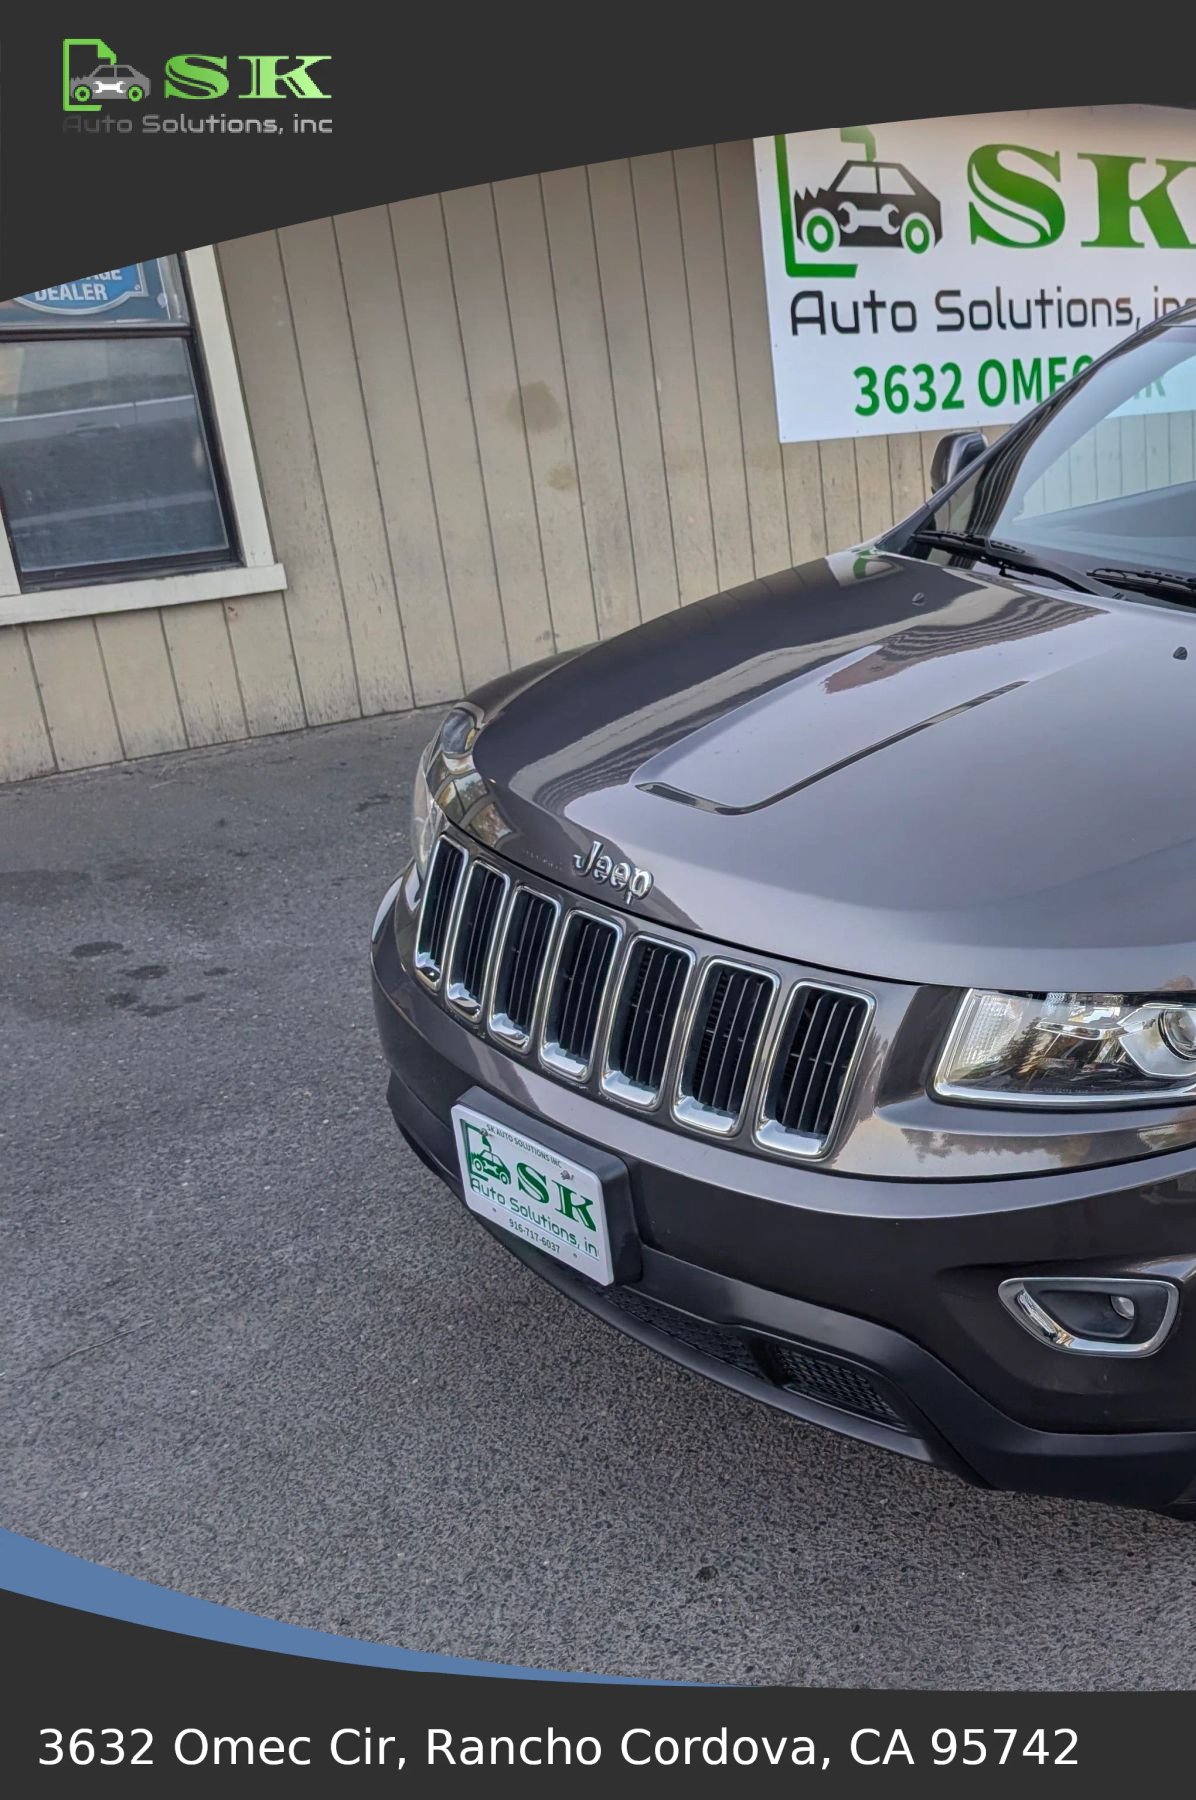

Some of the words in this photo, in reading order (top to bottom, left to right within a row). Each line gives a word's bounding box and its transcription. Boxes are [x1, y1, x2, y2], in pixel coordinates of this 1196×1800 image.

[790, 289, 918, 337] Auto
[934, 285, 1142, 333] Solutions,
[852, 361, 965, 417] 3632
[573, 840, 653, 905] Jeep
[470, 1178, 506, 1206] Auto
[509, 1197, 581, 1249] Solutions,
[584, 1236, 600, 1258] in
[516, 1162, 597, 1232] SK
[508, 1218, 561, 1254] 916-717-6037
